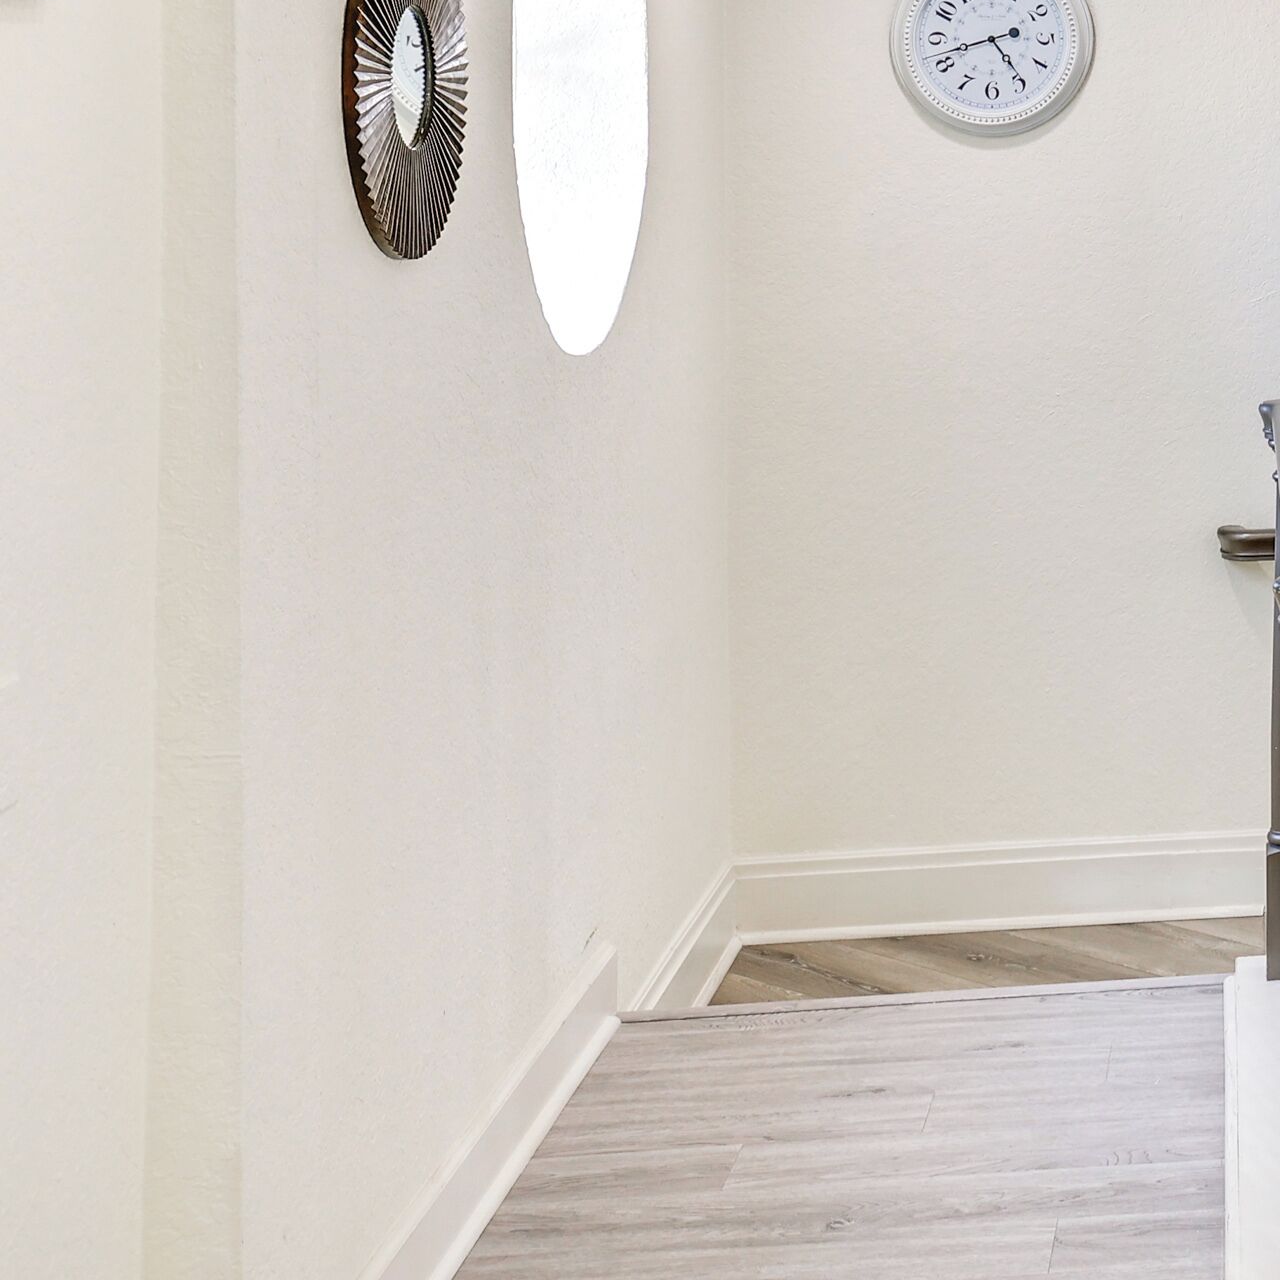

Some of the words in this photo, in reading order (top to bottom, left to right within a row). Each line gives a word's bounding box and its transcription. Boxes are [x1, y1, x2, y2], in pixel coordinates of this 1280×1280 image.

[935, 0, 958, 22] 10
[1027, 3, 1048, 22] 2
[927, 31, 948, 46] 9
[1036, 32, 1056, 46] 3
[935, 56, 956, 74] 8
[1031, 57, 1048, 75] 4
[957, 74, 976, 91] 7
[984, 81, 1000, 100] 6
[1011, 74, 1027, 94] 5
